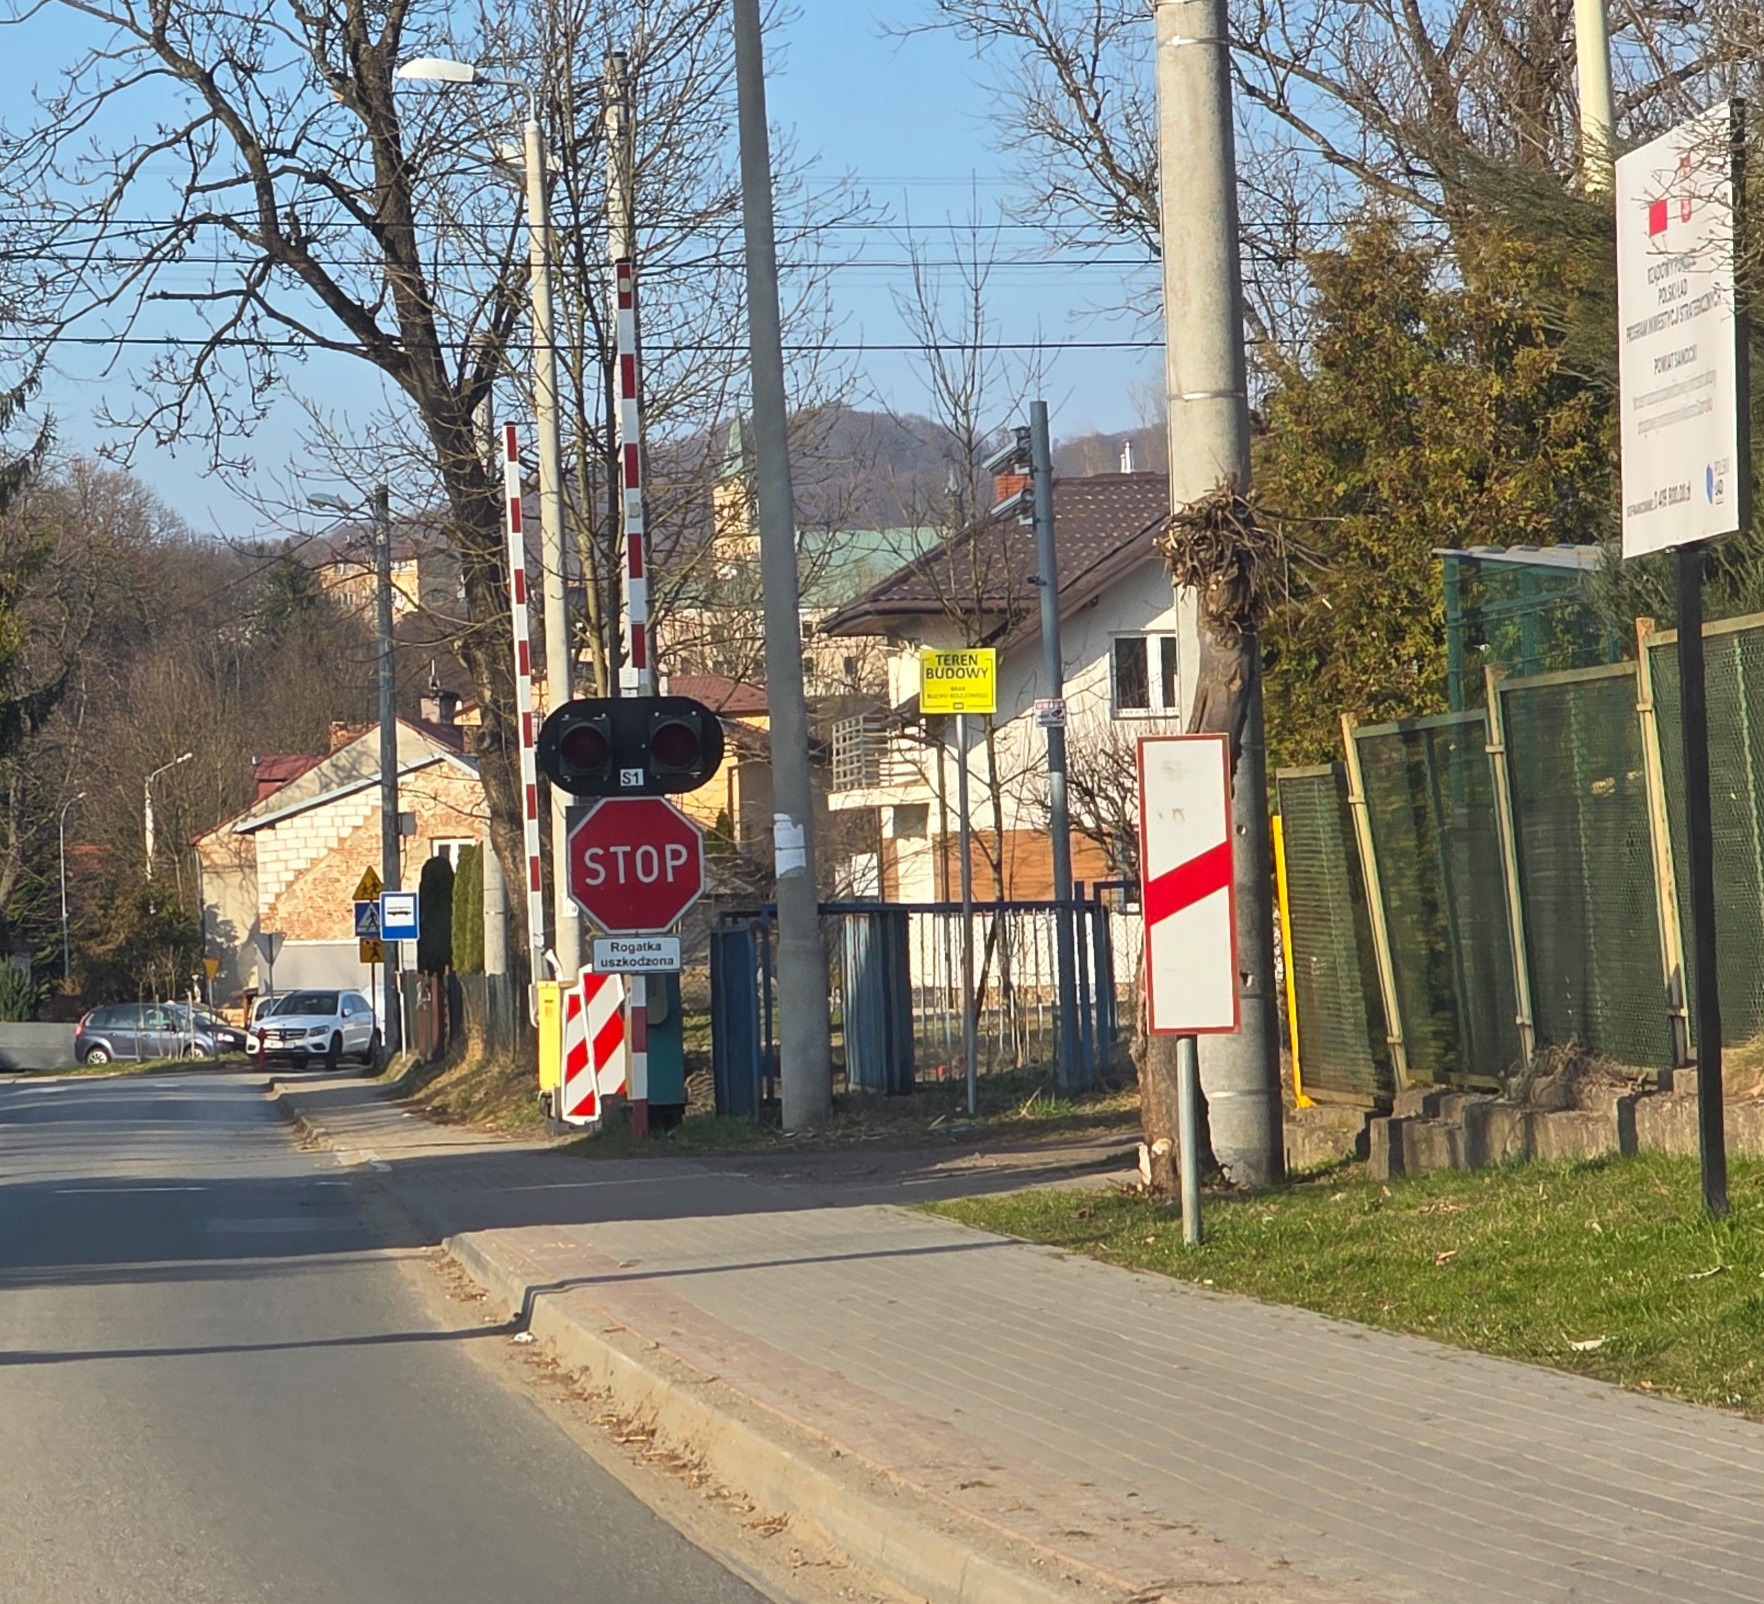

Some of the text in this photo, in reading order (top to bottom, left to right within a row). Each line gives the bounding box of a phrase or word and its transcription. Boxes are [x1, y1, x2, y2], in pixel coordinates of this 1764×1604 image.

[935, 654, 978, 666] TEREN
[926, 667, 988, 679] BUDOWY
[622, 771, 640, 785] S1
[584, 843, 688, 886] STOP
[610, 942, 662, 954] Rogatka
[600, 956, 674, 968] uszkodzona
